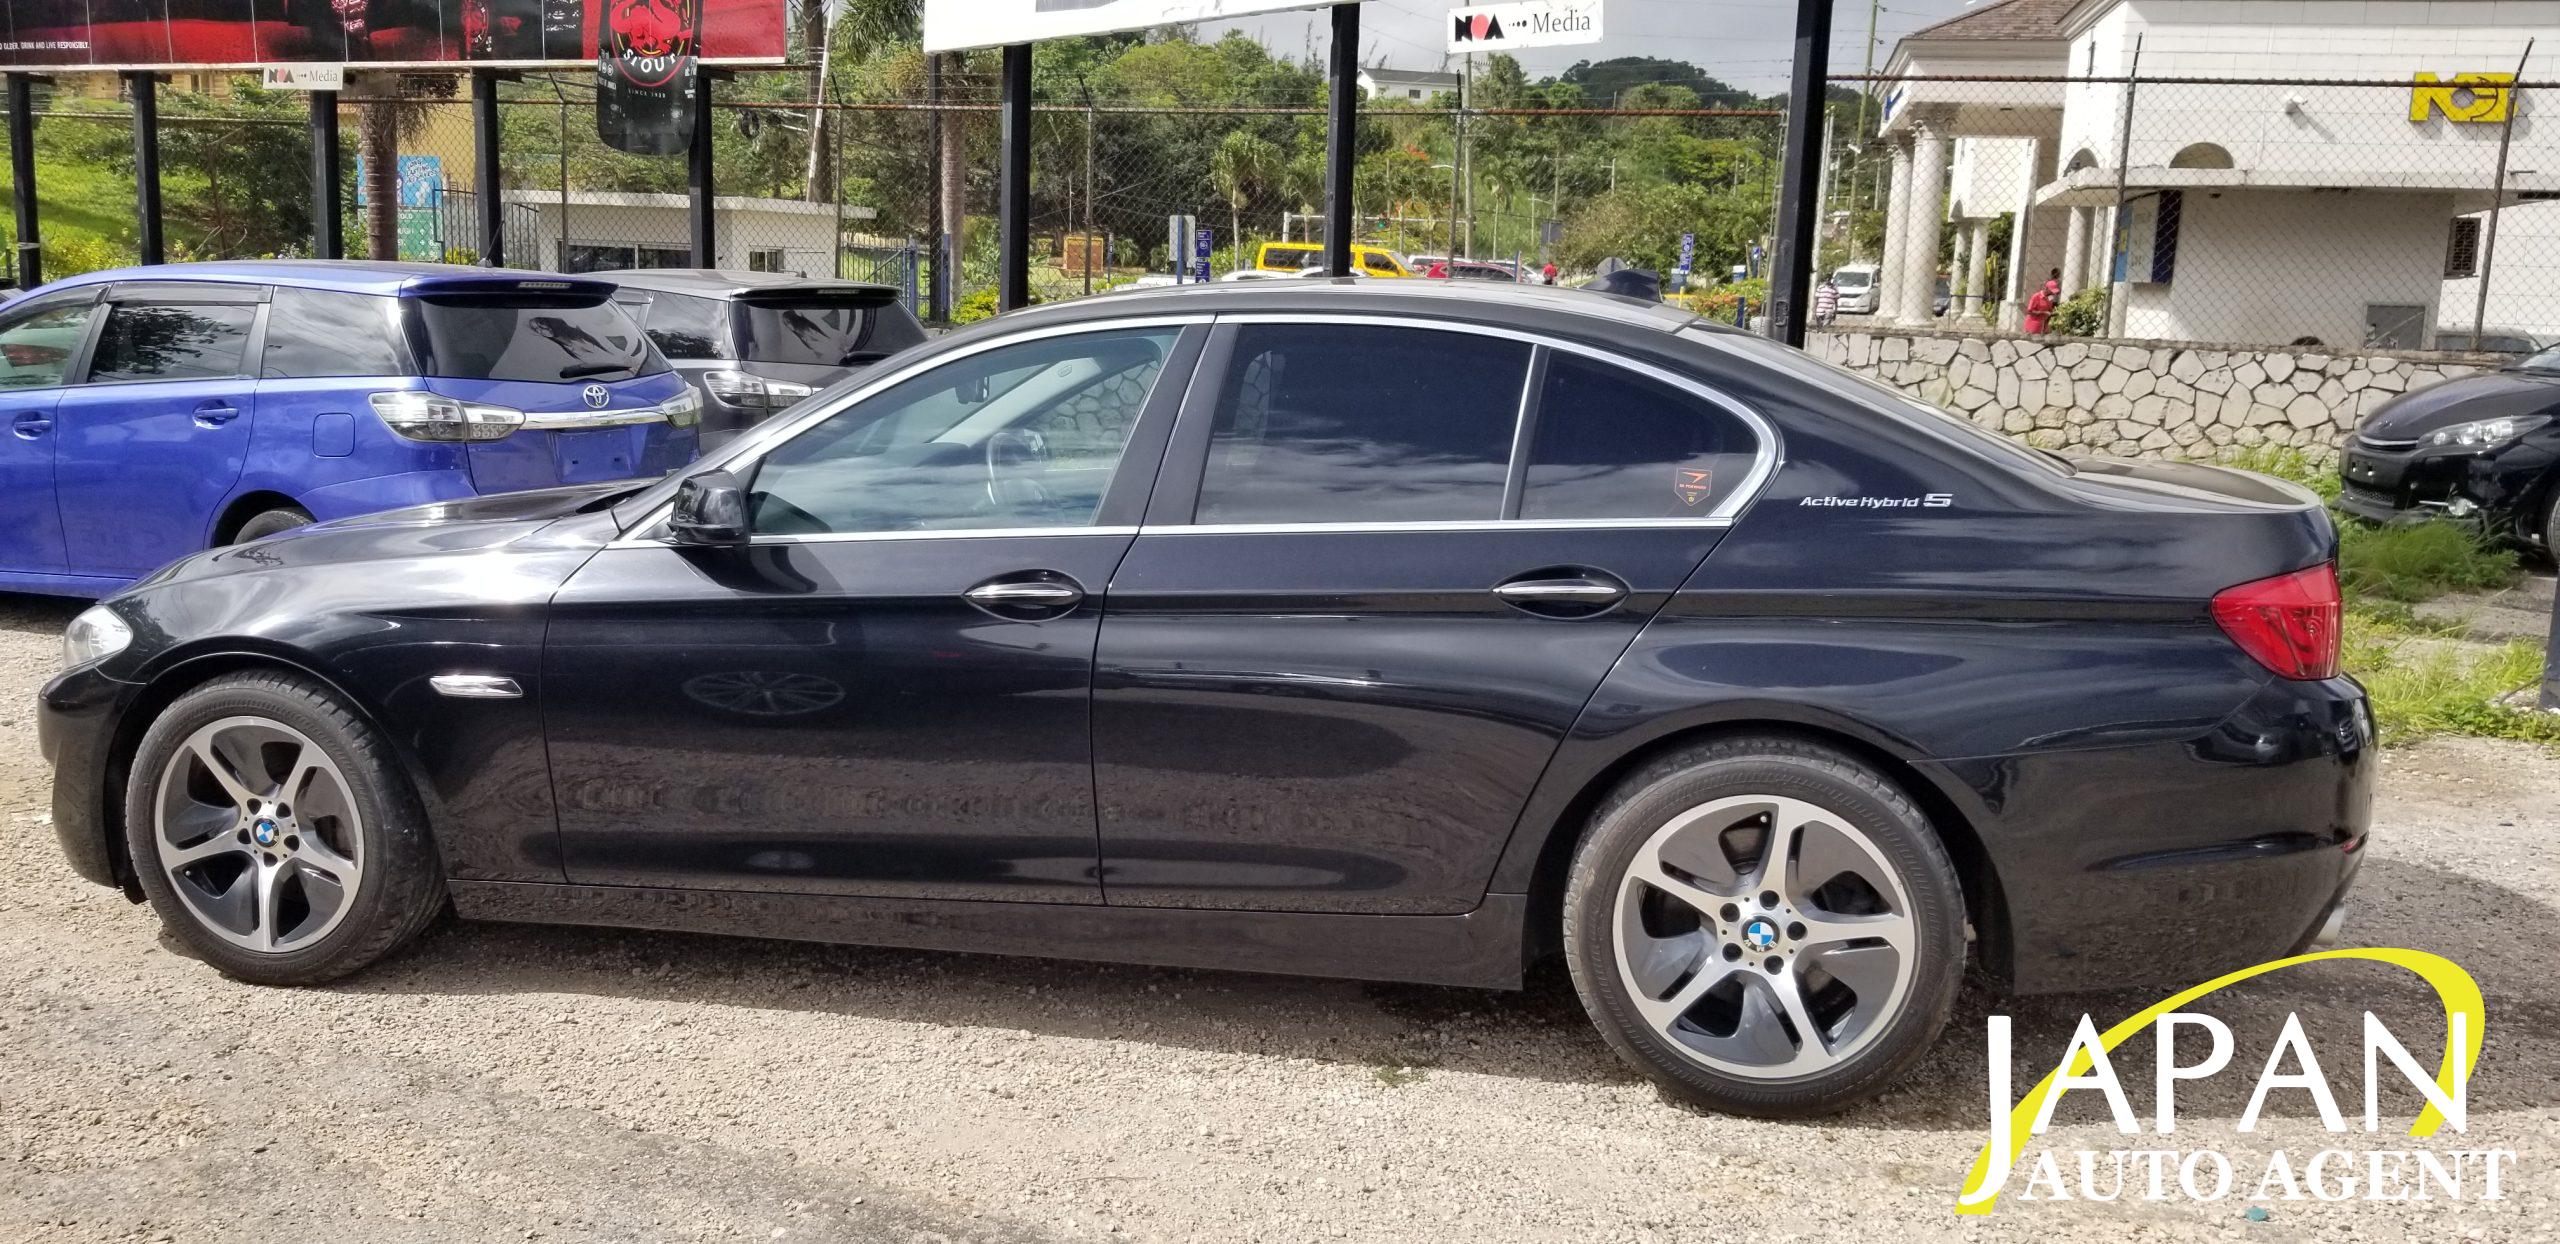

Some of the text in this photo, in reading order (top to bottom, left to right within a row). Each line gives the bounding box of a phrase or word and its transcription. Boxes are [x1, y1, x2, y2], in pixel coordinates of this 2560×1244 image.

[1532, 9, 1591, 34] Media
[35, 41, 45, 49] AND
[46, 41, 56, 49] LIVE
[623, 48, 677, 73] STOUT
[309, 68, 338, 82] Media
[1799, 493, 1954, 509] Active Hybrid 5
